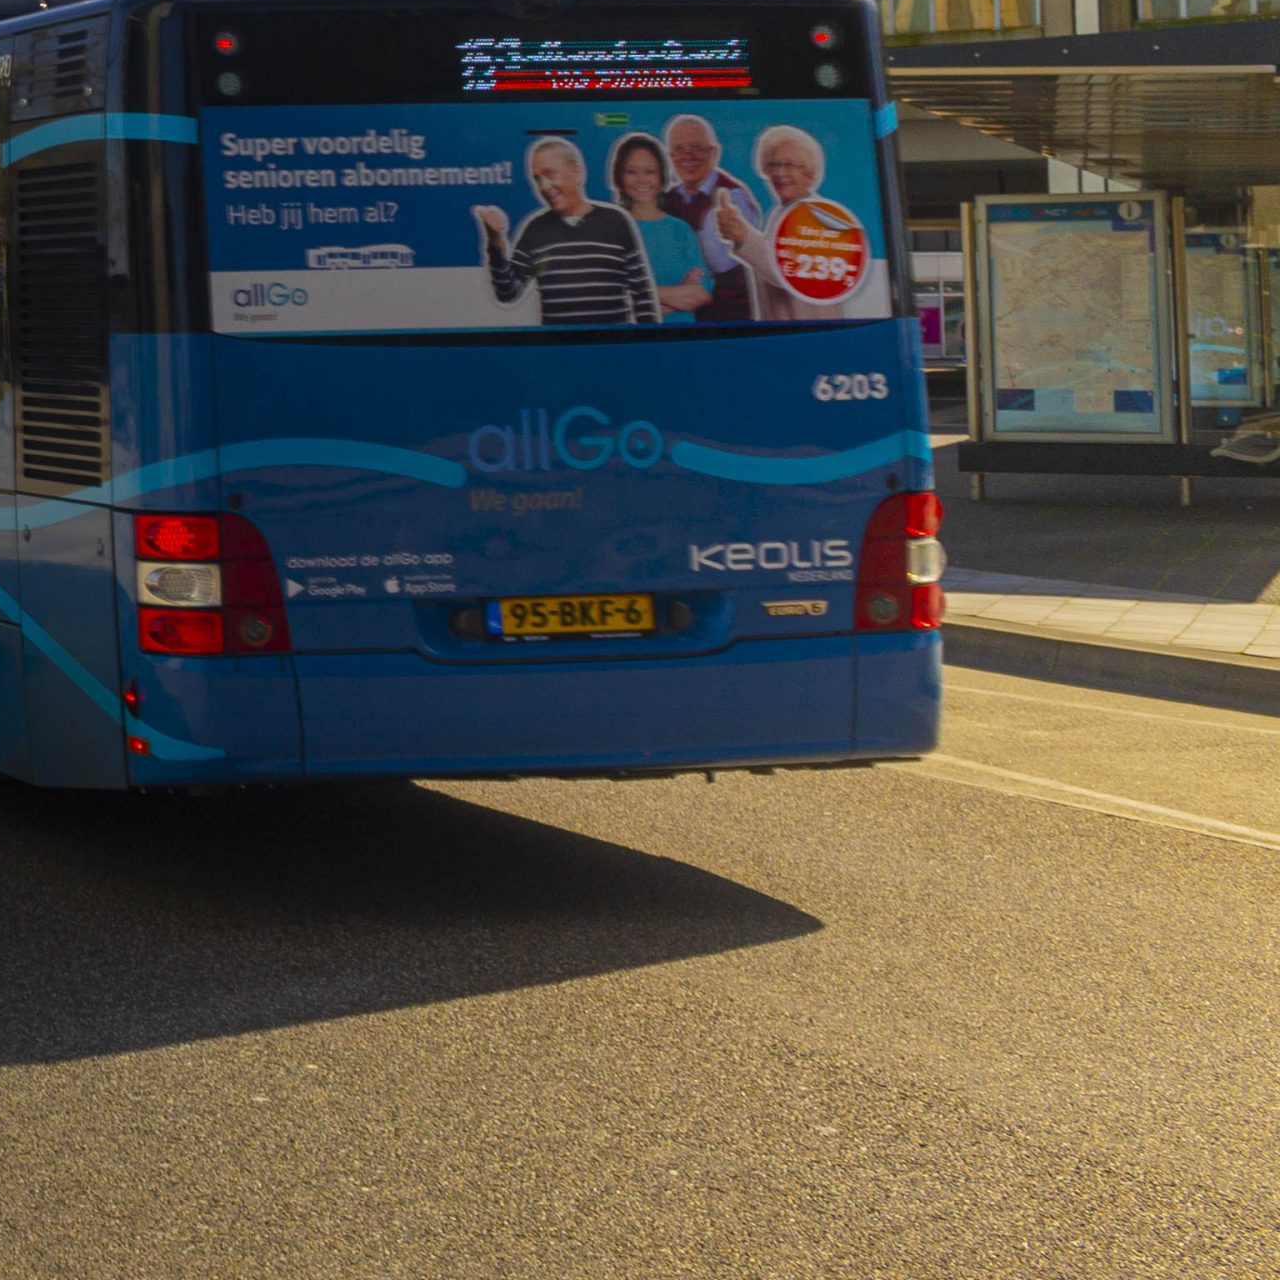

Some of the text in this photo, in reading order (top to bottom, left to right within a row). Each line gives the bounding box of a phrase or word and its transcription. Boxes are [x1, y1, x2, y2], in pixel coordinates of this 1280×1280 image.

[220, 128, 427, 161] Super voordelig
[224, 161, 512, 189] senioren abonnement!
[227, 201, 399, 229] Heb jij hem al?
[233, 282, 309, 307] allGo
[813, 373, 889, 401] 6203
[469, 406, 664, 472] allGo
[469, 486, 584, 517] We gaan!
[287, 554, 357, 568] download
[360, 554, 379, 566] de
[423, 552, 454, 565] app
[787, 570, 855, 582] NEDERLAND
[307, 585, 344, 598] Google
[509, 598, 644, 629] 95-BKF-6
